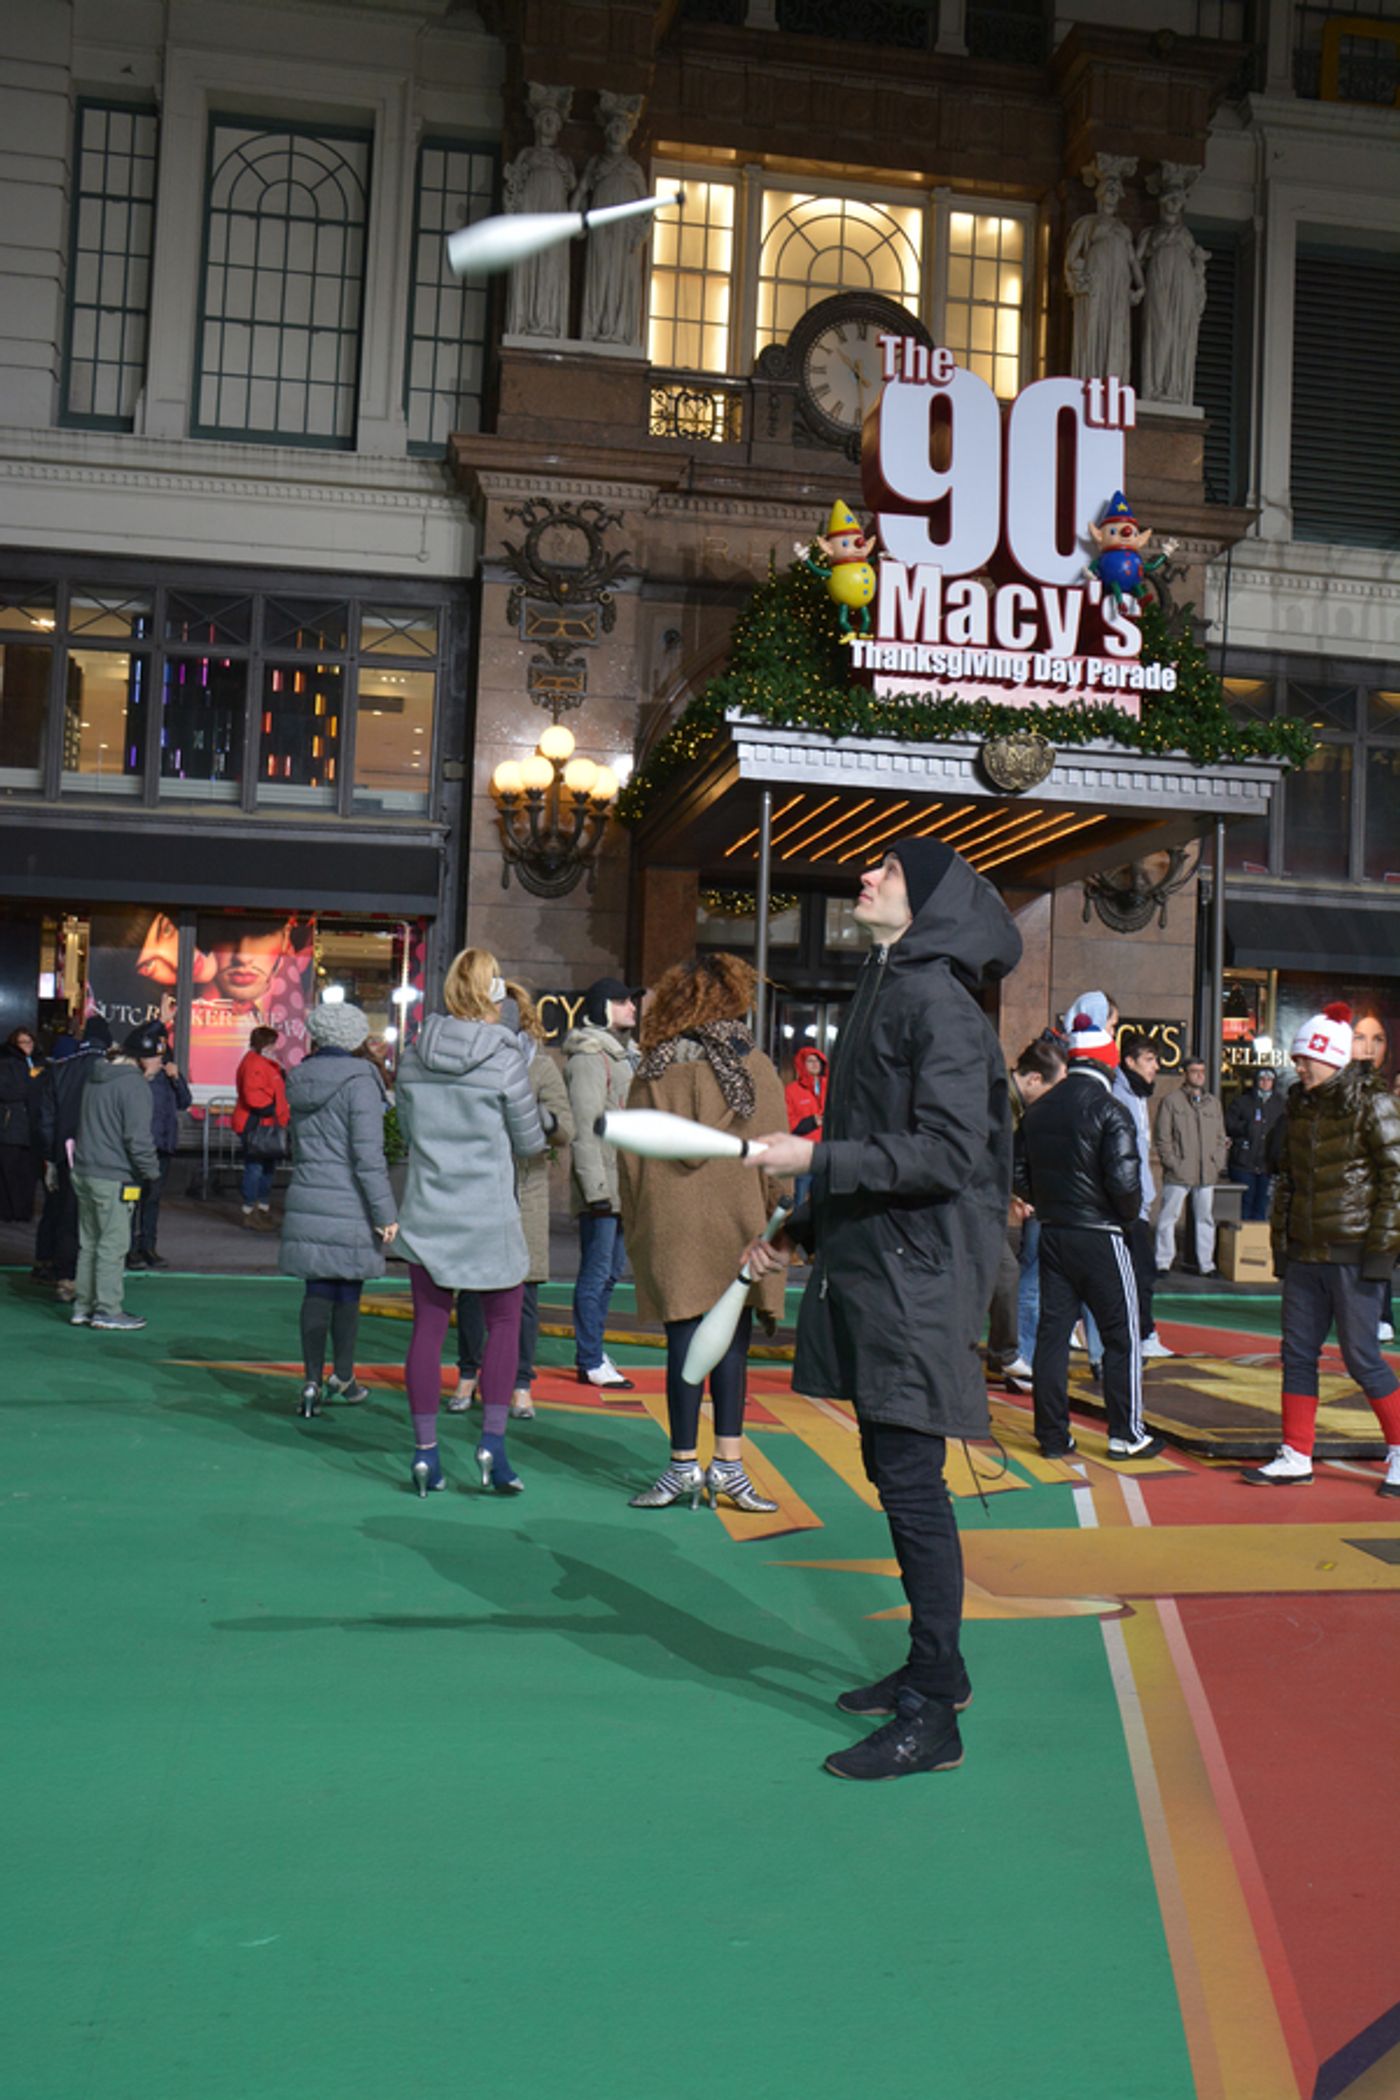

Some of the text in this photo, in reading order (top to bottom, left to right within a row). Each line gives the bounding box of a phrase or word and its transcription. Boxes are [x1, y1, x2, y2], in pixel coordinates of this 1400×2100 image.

[878, 334, 955, 386] The
[877, 368, 1136, 588] 90th
[877, 562, 1142, 658] Macy's
[850, 641, 1178, 692] Thanksgiving Day Parade
